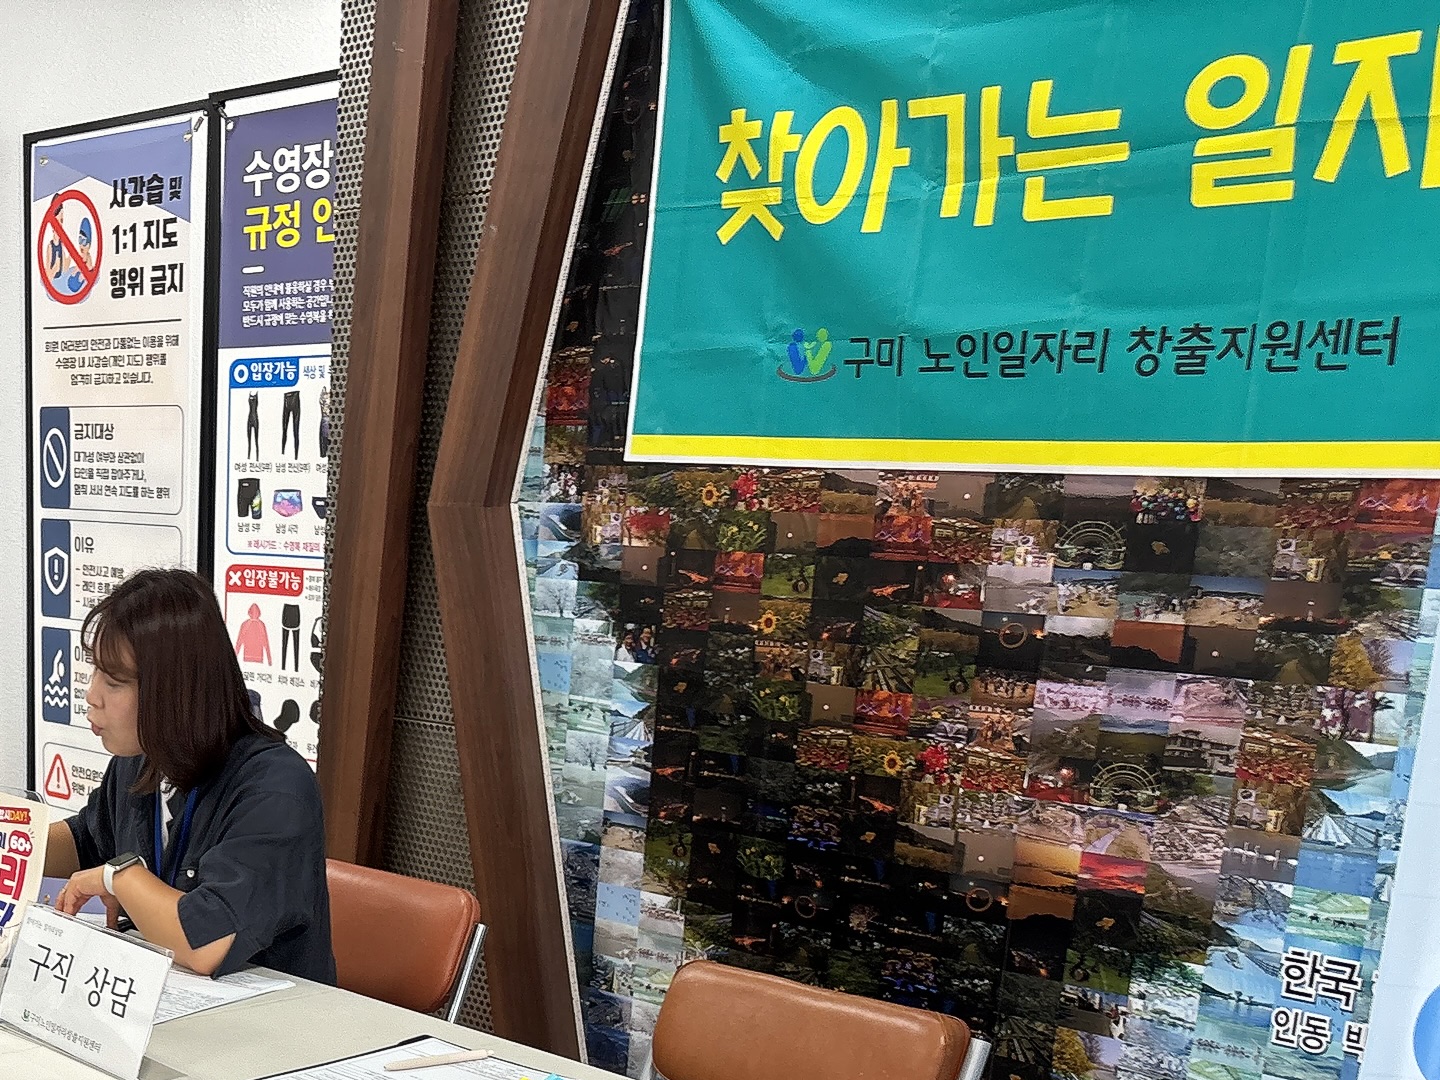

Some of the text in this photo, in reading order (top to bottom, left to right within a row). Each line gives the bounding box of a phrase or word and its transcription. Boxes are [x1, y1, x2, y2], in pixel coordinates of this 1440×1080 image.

[716, 24, 1440, 245] 찾아가는 일자
[242, 139, 334, 197] 수영장
[109, 173, 183, 209] 사강습 및
[112, 217, 178, 255] 1:1 지도
[242, 199, 300, 251] 규정
[110, 262, 184, 299] 행위 금지
[843, 314, 1402, 379] 구미 노인일자리 창출지원센터
[94, 372, 121, 386] 금지하고
[122, 371, 154, 384] 있습니다.
[250, 361, 297, 382] 입장가능
[74, 423, 114, 440] 금지대상
[74, 536, 94, 554] 이유
[82, 564, 109, 578] 안전사고
[242, 568, 302, 591] 입장불가능
[28, 944, 74, 994] 구직
[84, 966, 136, 1018] 상담
[1282, 946, 1363, 1011] 한국
[1271, 1006, 1331, 1054] 인동
